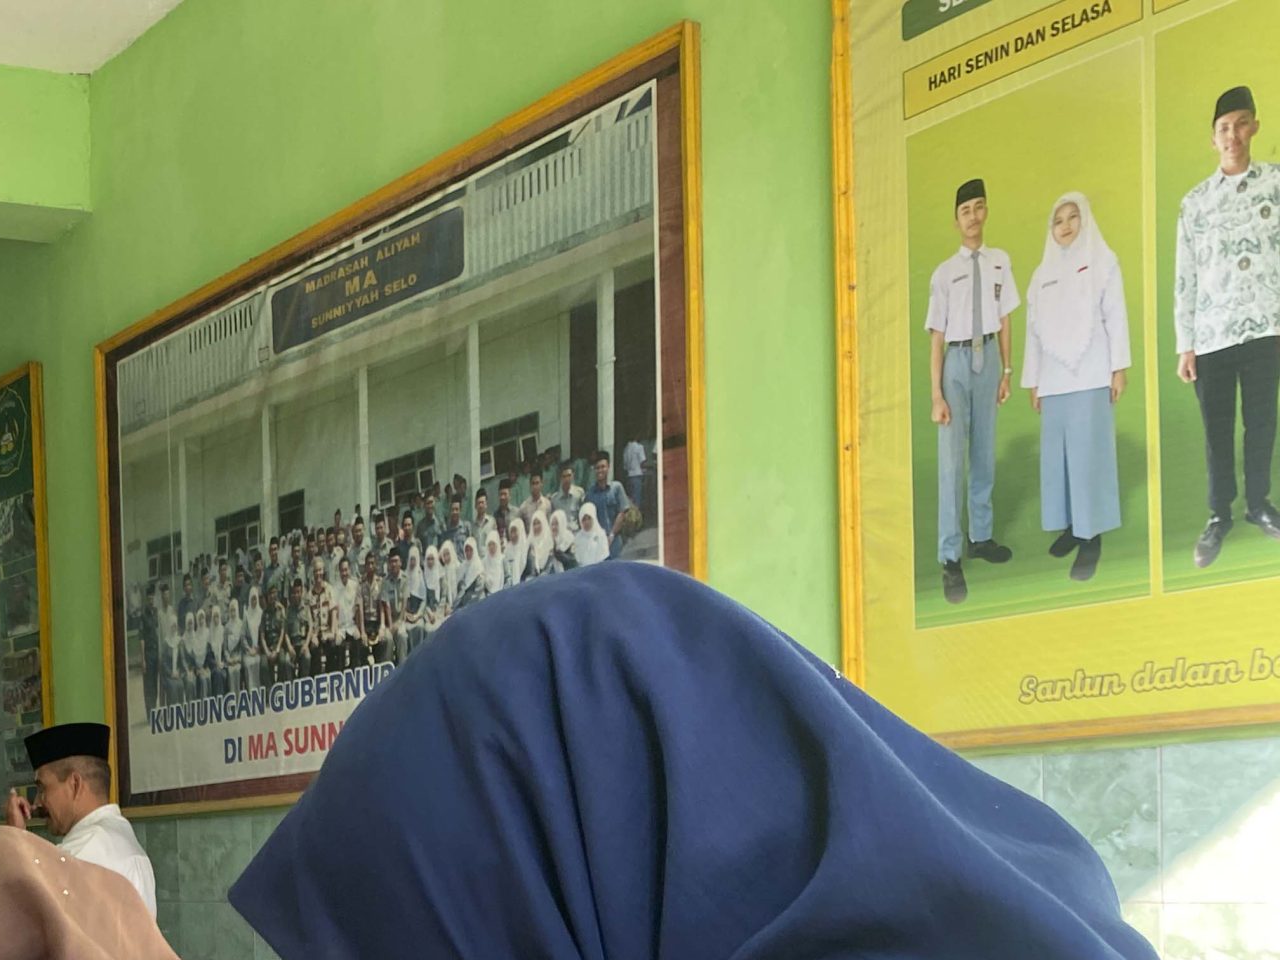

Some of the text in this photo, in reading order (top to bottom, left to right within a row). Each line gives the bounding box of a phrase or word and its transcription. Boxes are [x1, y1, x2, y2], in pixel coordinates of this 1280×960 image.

[927, 0, 1113, 92] HARI SENIN DAN SELASA
[305, 232, 421, 294] MADRASAH ALIYAH
[345, 269, 378, 297] MA
[311, 273, 417, 328] SUNNIYYAH SELO
[1019, 669, 1125, 704] Santun
[1131, 657, 1244, 693] dalam
[150, 686, 266, 735] KUNJUNGAN
[224, 736, 243, 764] DI
[248, 731, 279, 761] MA
